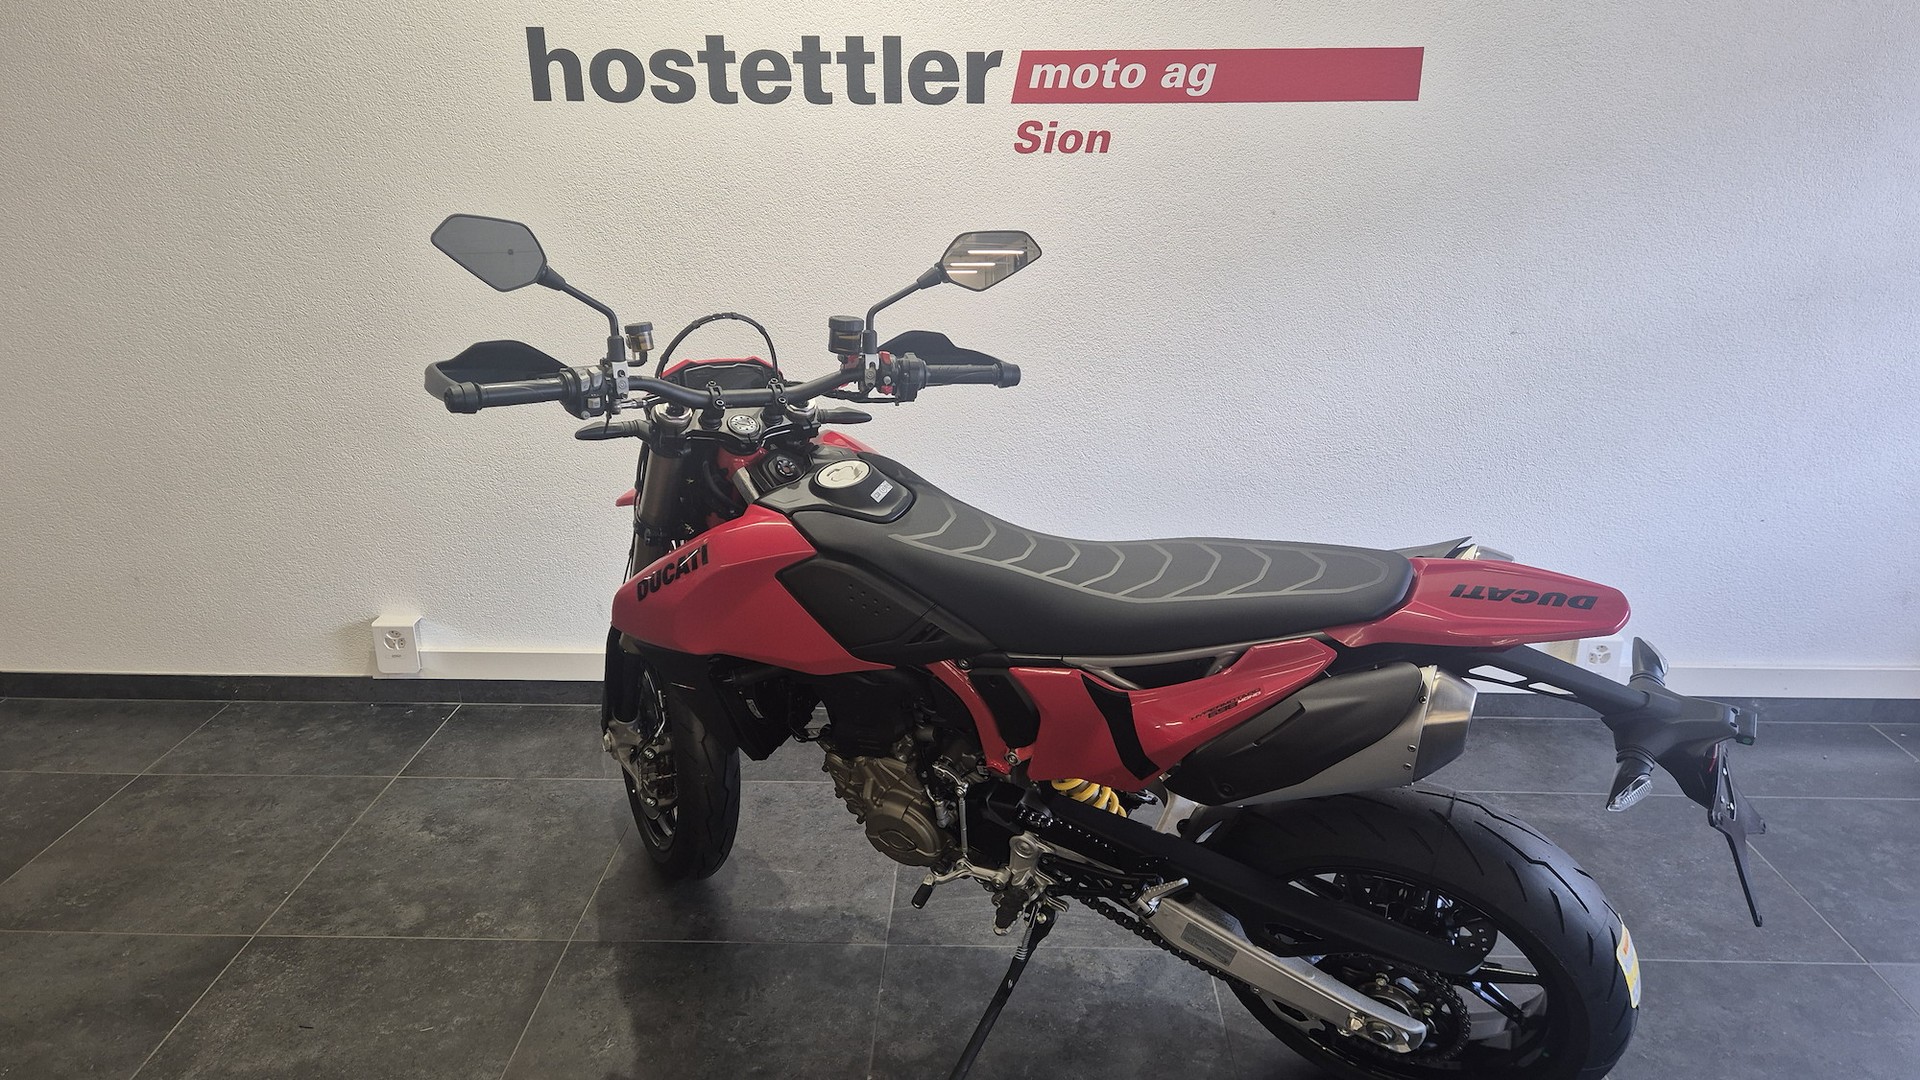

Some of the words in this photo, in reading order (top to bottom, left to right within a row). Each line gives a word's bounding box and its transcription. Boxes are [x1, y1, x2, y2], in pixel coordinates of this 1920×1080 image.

[526, 27, 1003, 105] hostettler
[1028, 57, 1147, 89] moto
[1160, 62, 1217, 97] ag
[1013, 120, 1112, 154] Sion
[636, 543, 709, 602] DUCATI
[1449, 583, 1599, 610] DUCATI
